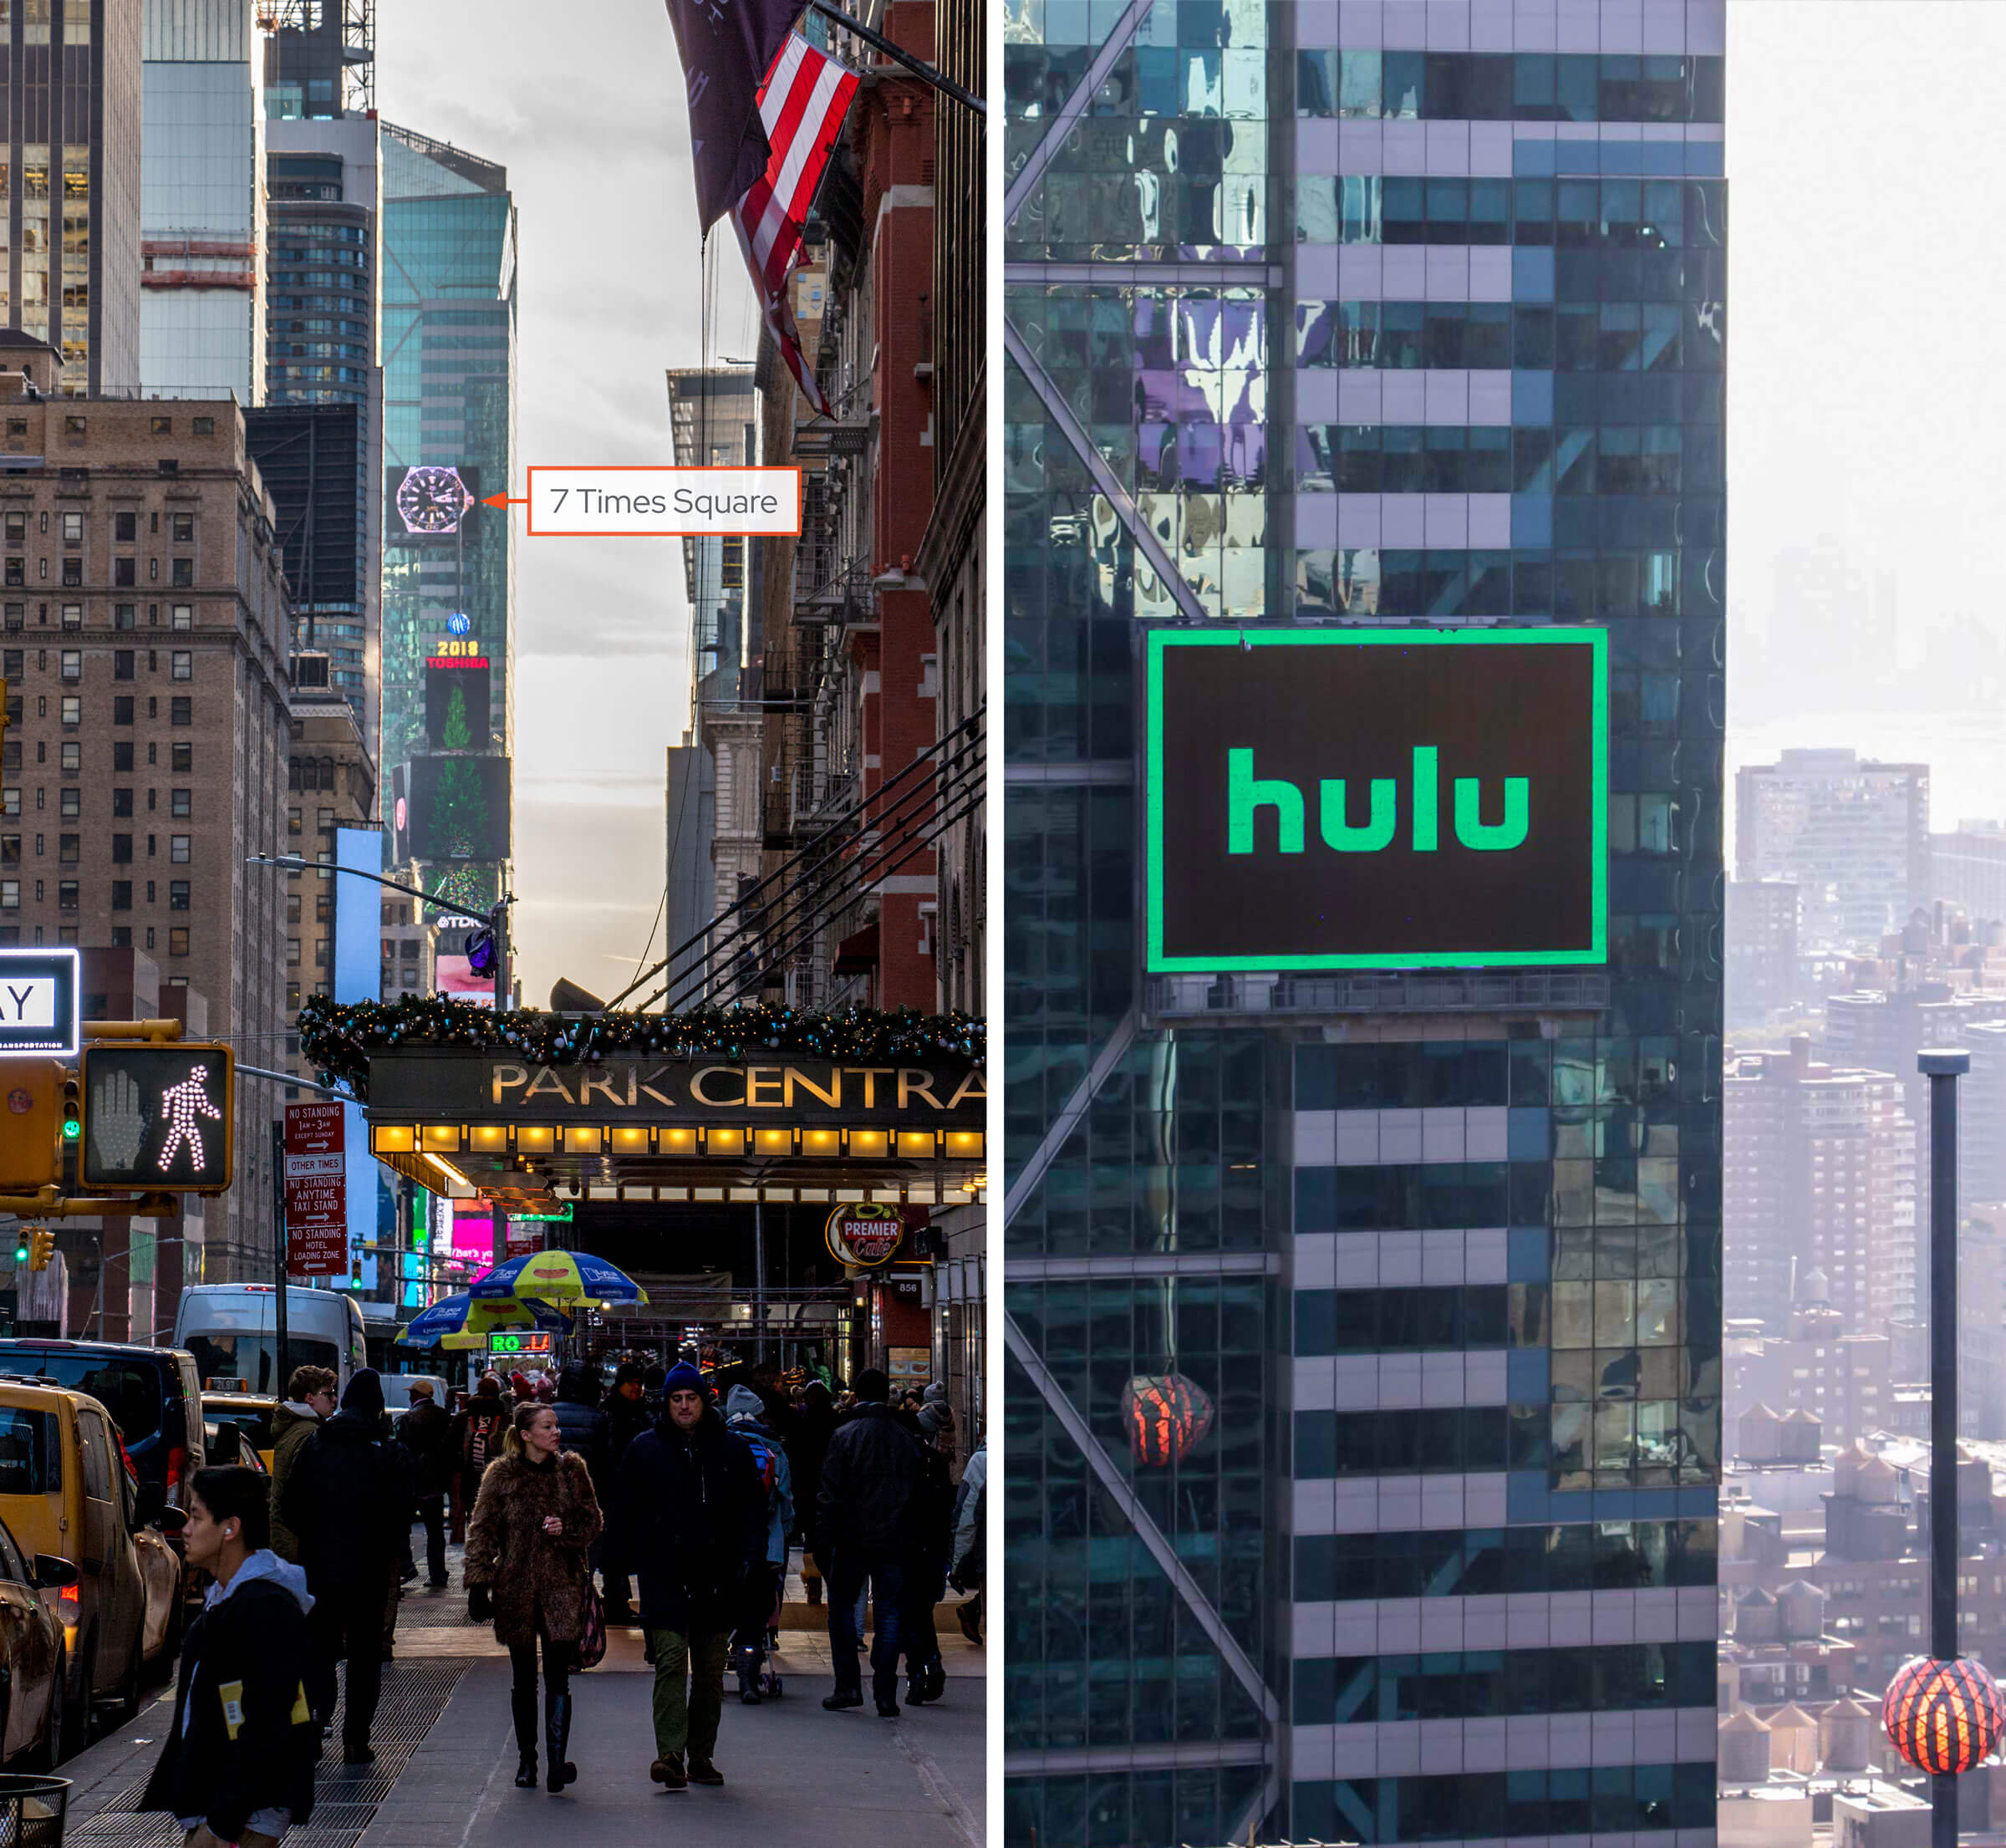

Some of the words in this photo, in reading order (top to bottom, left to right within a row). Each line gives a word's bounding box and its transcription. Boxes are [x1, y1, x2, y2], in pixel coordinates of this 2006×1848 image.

[437, 640, 479, 656] 2018
[425, 657, 489, 669] TOSHIBA
[1229, 746, 1529, 854] hulu
[448, 916, 482, 928] TDK
[491, 1064, 678, 1107] PARK
[690, 1067, 986, 1110] CENTRA
[289, 1108, 300, 1119] NO
[303, 1106, 339, 1118] STANDING
[291, 1161, 315, 1171] OTHER
[318, 1158, 339, 1169] TIMES
[289, 1179, 300, 1189] NO
[304, 1177, 341, 1189] STANDING
[296, 1189, 335, 1200] ANYTIME
[293, 1202, 311, 1212] TAXI
[313, 1199, 339, 1211] STAND
[293, 1229, 303, 1240] NO
[306, 1228, 341, 1239] STANDING
[845, 1222, 899, 1236] PREMIER
[306, 1241, 328, 1250] HOTEL
[853, 1237, 891, 1257] Café
[293, 1252, 321, 1260] LOADING
[323, 1250, 340, 1260] ZONE
[899, 1284, 917, 1292] 856
[492, 1336, 520, 1352] RO
